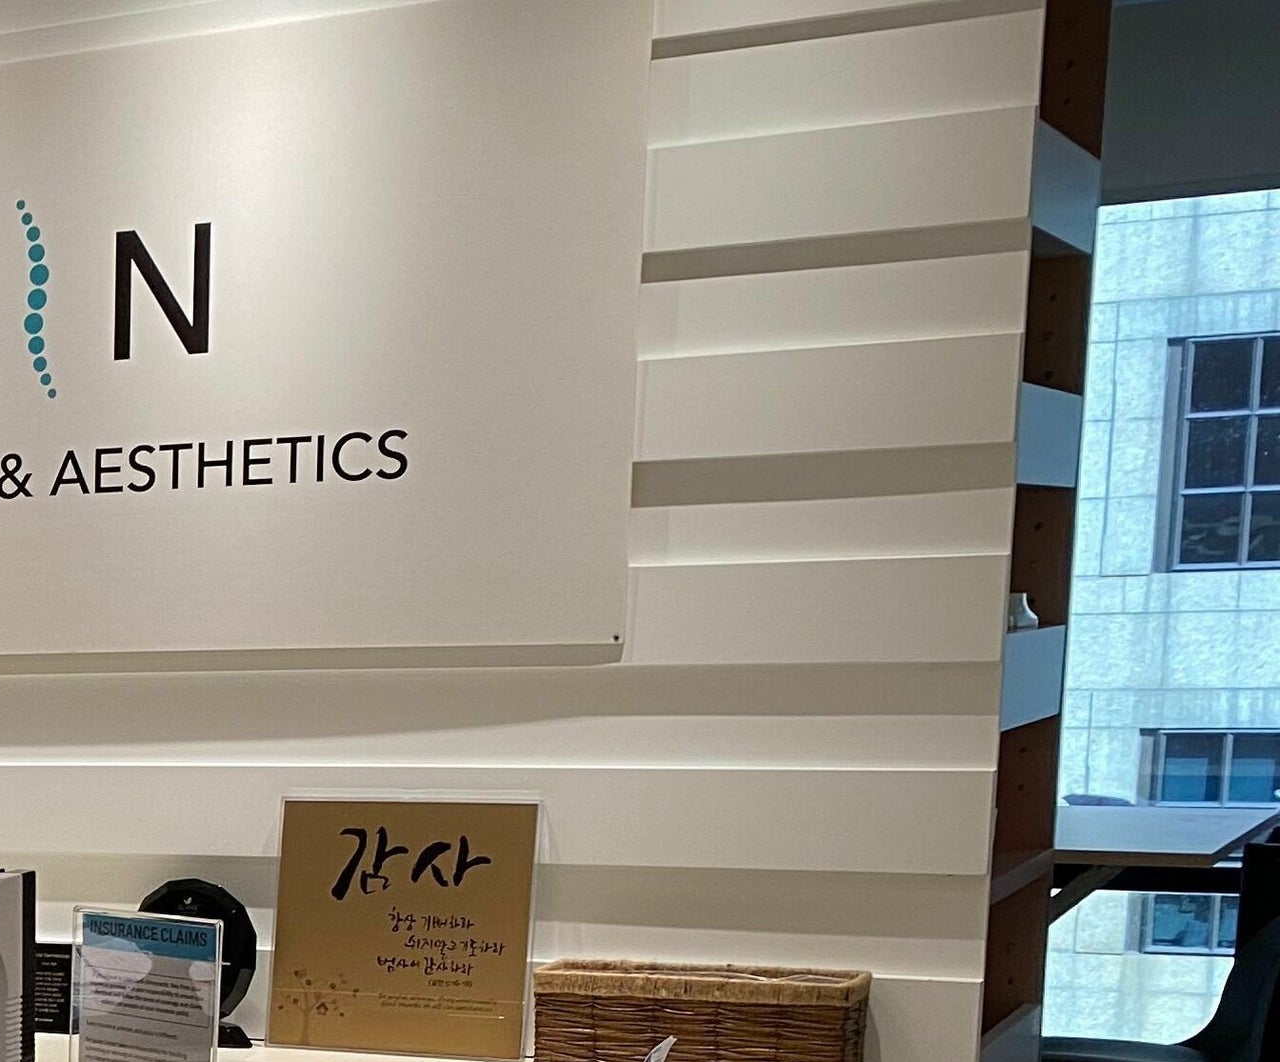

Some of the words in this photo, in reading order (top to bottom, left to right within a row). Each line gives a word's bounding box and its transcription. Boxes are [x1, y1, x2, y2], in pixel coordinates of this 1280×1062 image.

[50, 429, 409, 496] AESTHETICS
[331, 826, 492, 901] 감사
[90, 920, 159, 941] INSURANCE
[160, 928, 208, 947] CLAIMS
[388, 906, 416, 933] 항상
